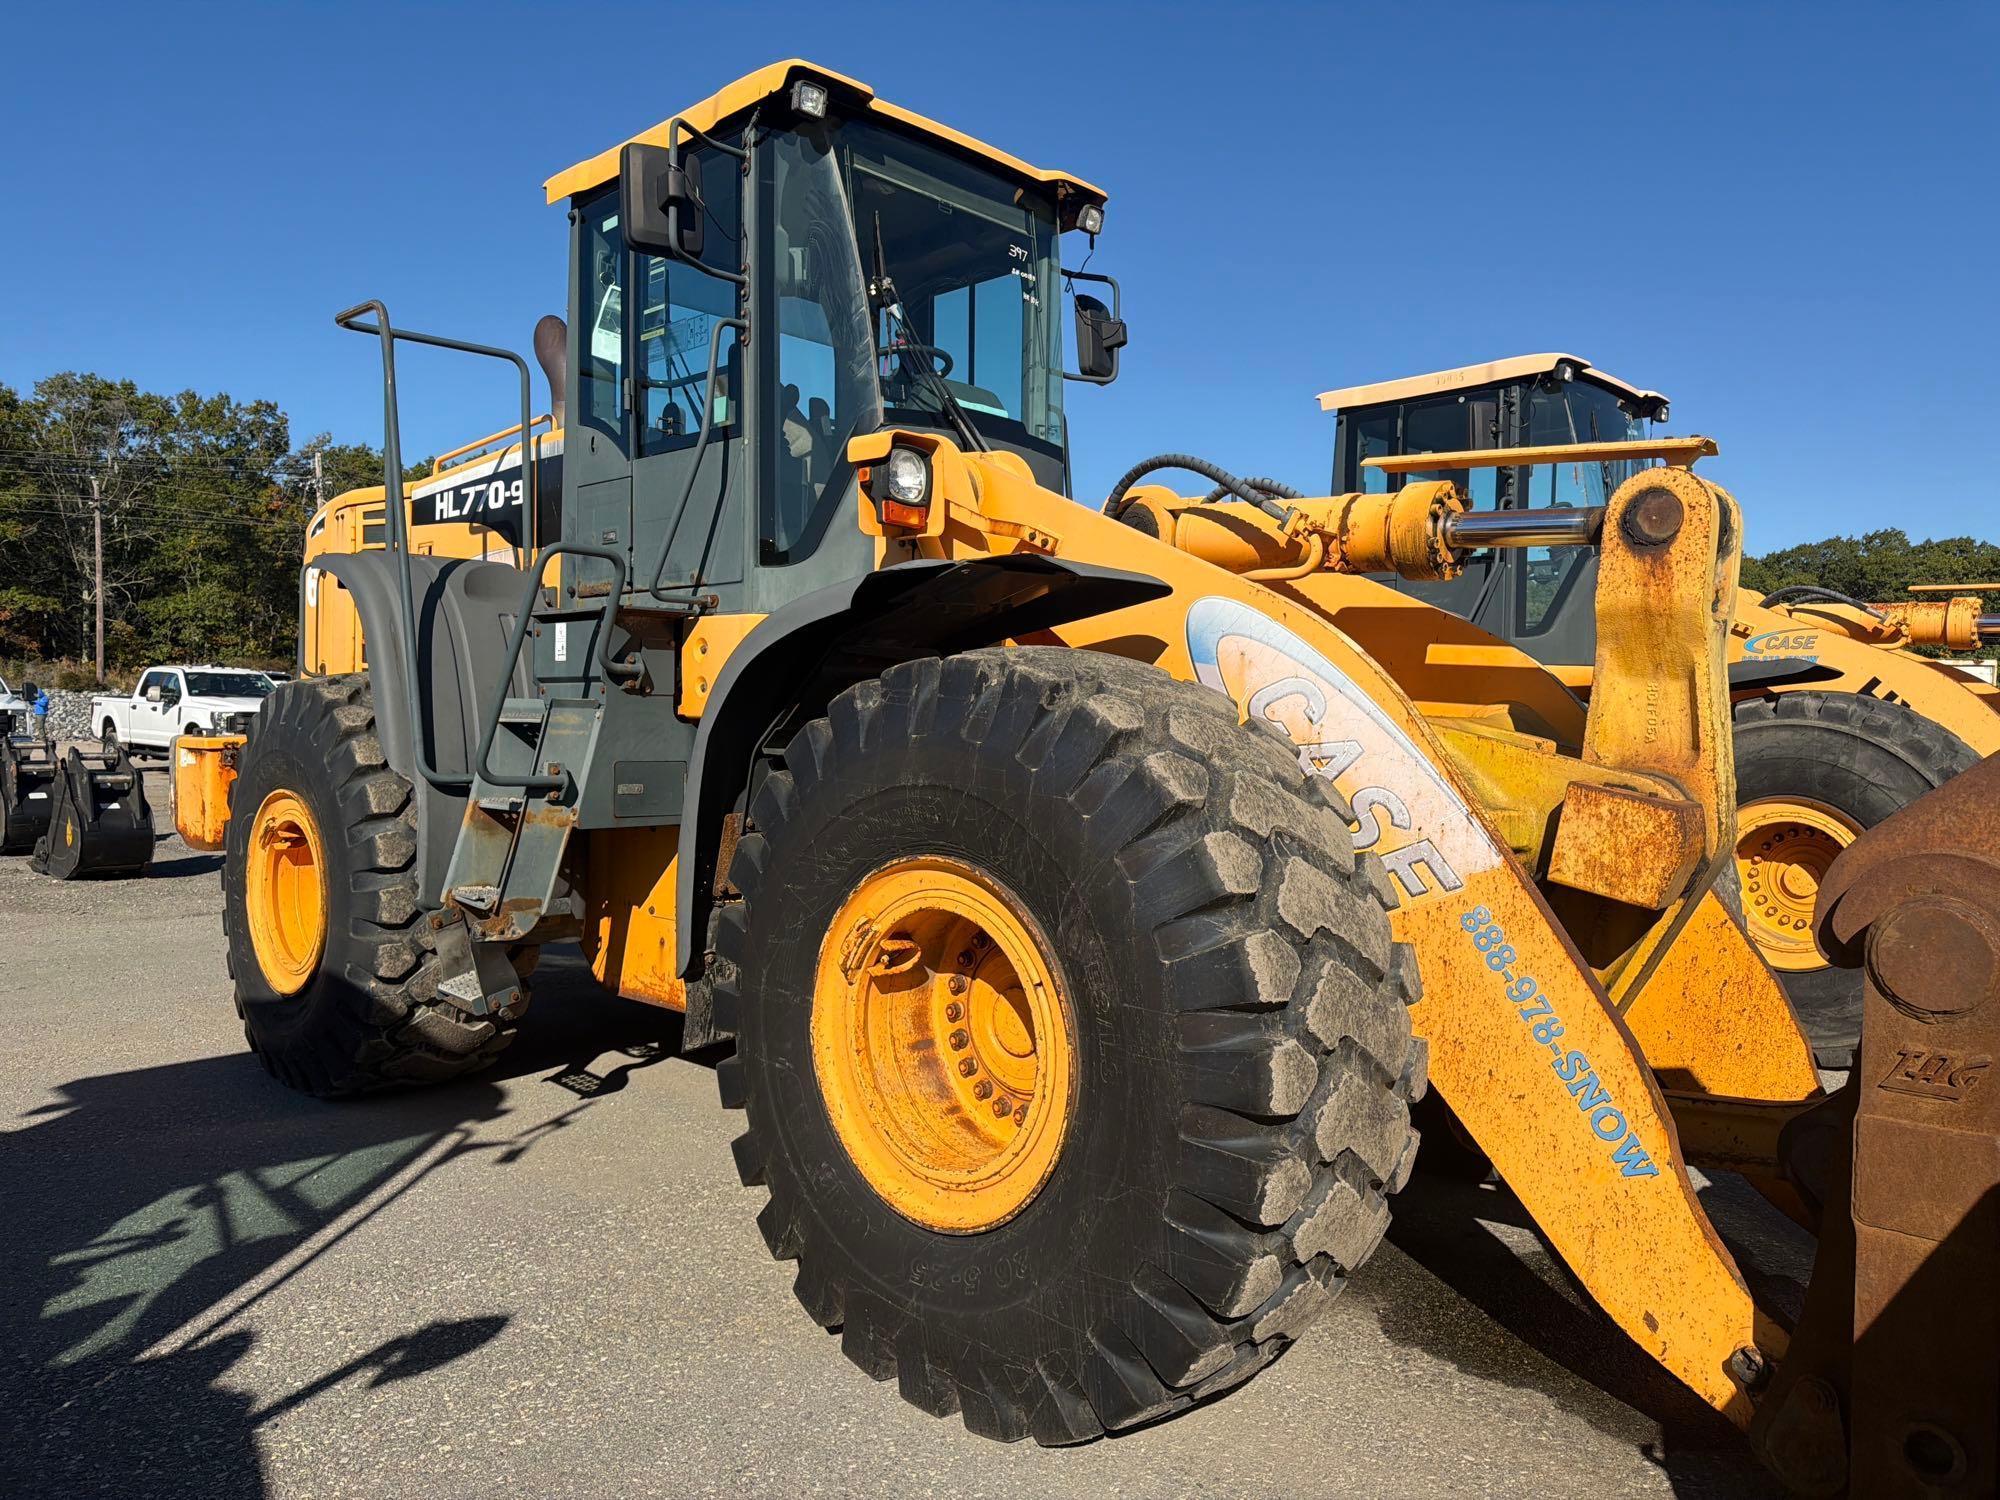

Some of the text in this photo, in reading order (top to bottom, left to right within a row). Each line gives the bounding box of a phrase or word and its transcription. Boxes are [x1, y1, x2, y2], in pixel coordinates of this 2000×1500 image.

[1008, 244, 1028, 262] 397
[435, 479, 524, 521] HL770-9
[1765, 635, 1819, 650] CASE
[1247, 675, 1464, 897] CASE
[1459, 904, 1660, 1179] 888-978-SNOW
